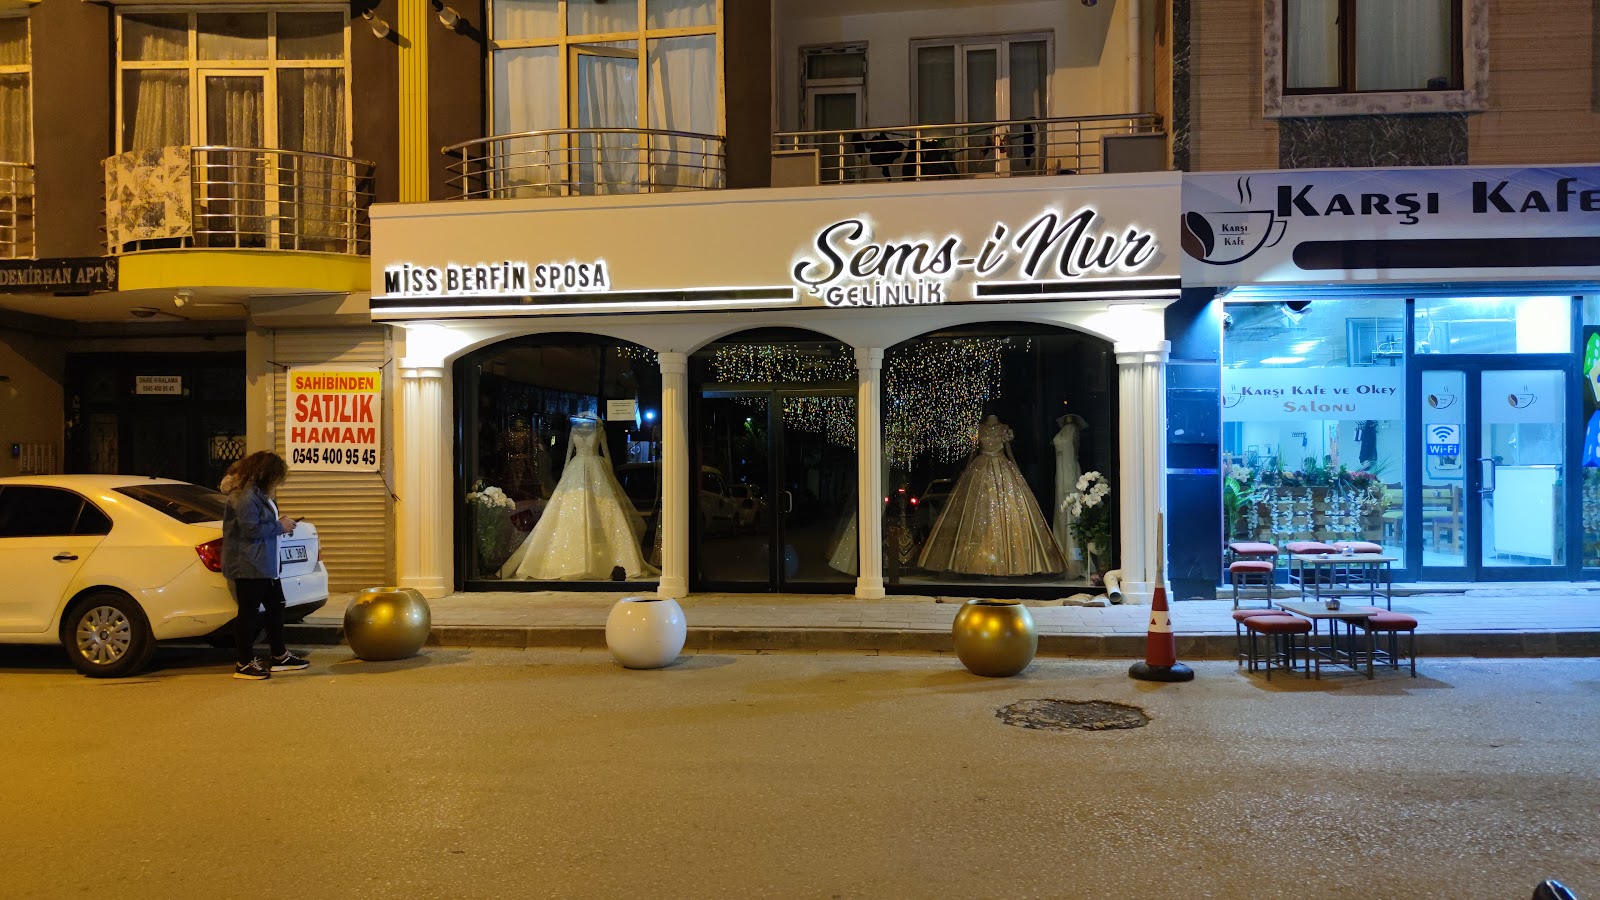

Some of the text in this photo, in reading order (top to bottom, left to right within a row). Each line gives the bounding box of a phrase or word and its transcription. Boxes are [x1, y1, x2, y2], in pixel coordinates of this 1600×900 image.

[1015, 209, 1155, 277] Nur
[0, 265, 104, 286] DEMİRHAN APT
[447, 262, 526, 292] BERFİN
[535, 264, 606, 289] SPOSA
[826, 279, 942, 306] GELİNLİK
[295, 373, 374, 390] SAHİBİNDEN
[294, 394, 374, 423] SATILIK
[291, 427, 376, 444] HAMAM
[292, 448, 376, 465] 0545 400 95 45
[1429, 445, 1457, 454] Wi-Fi
